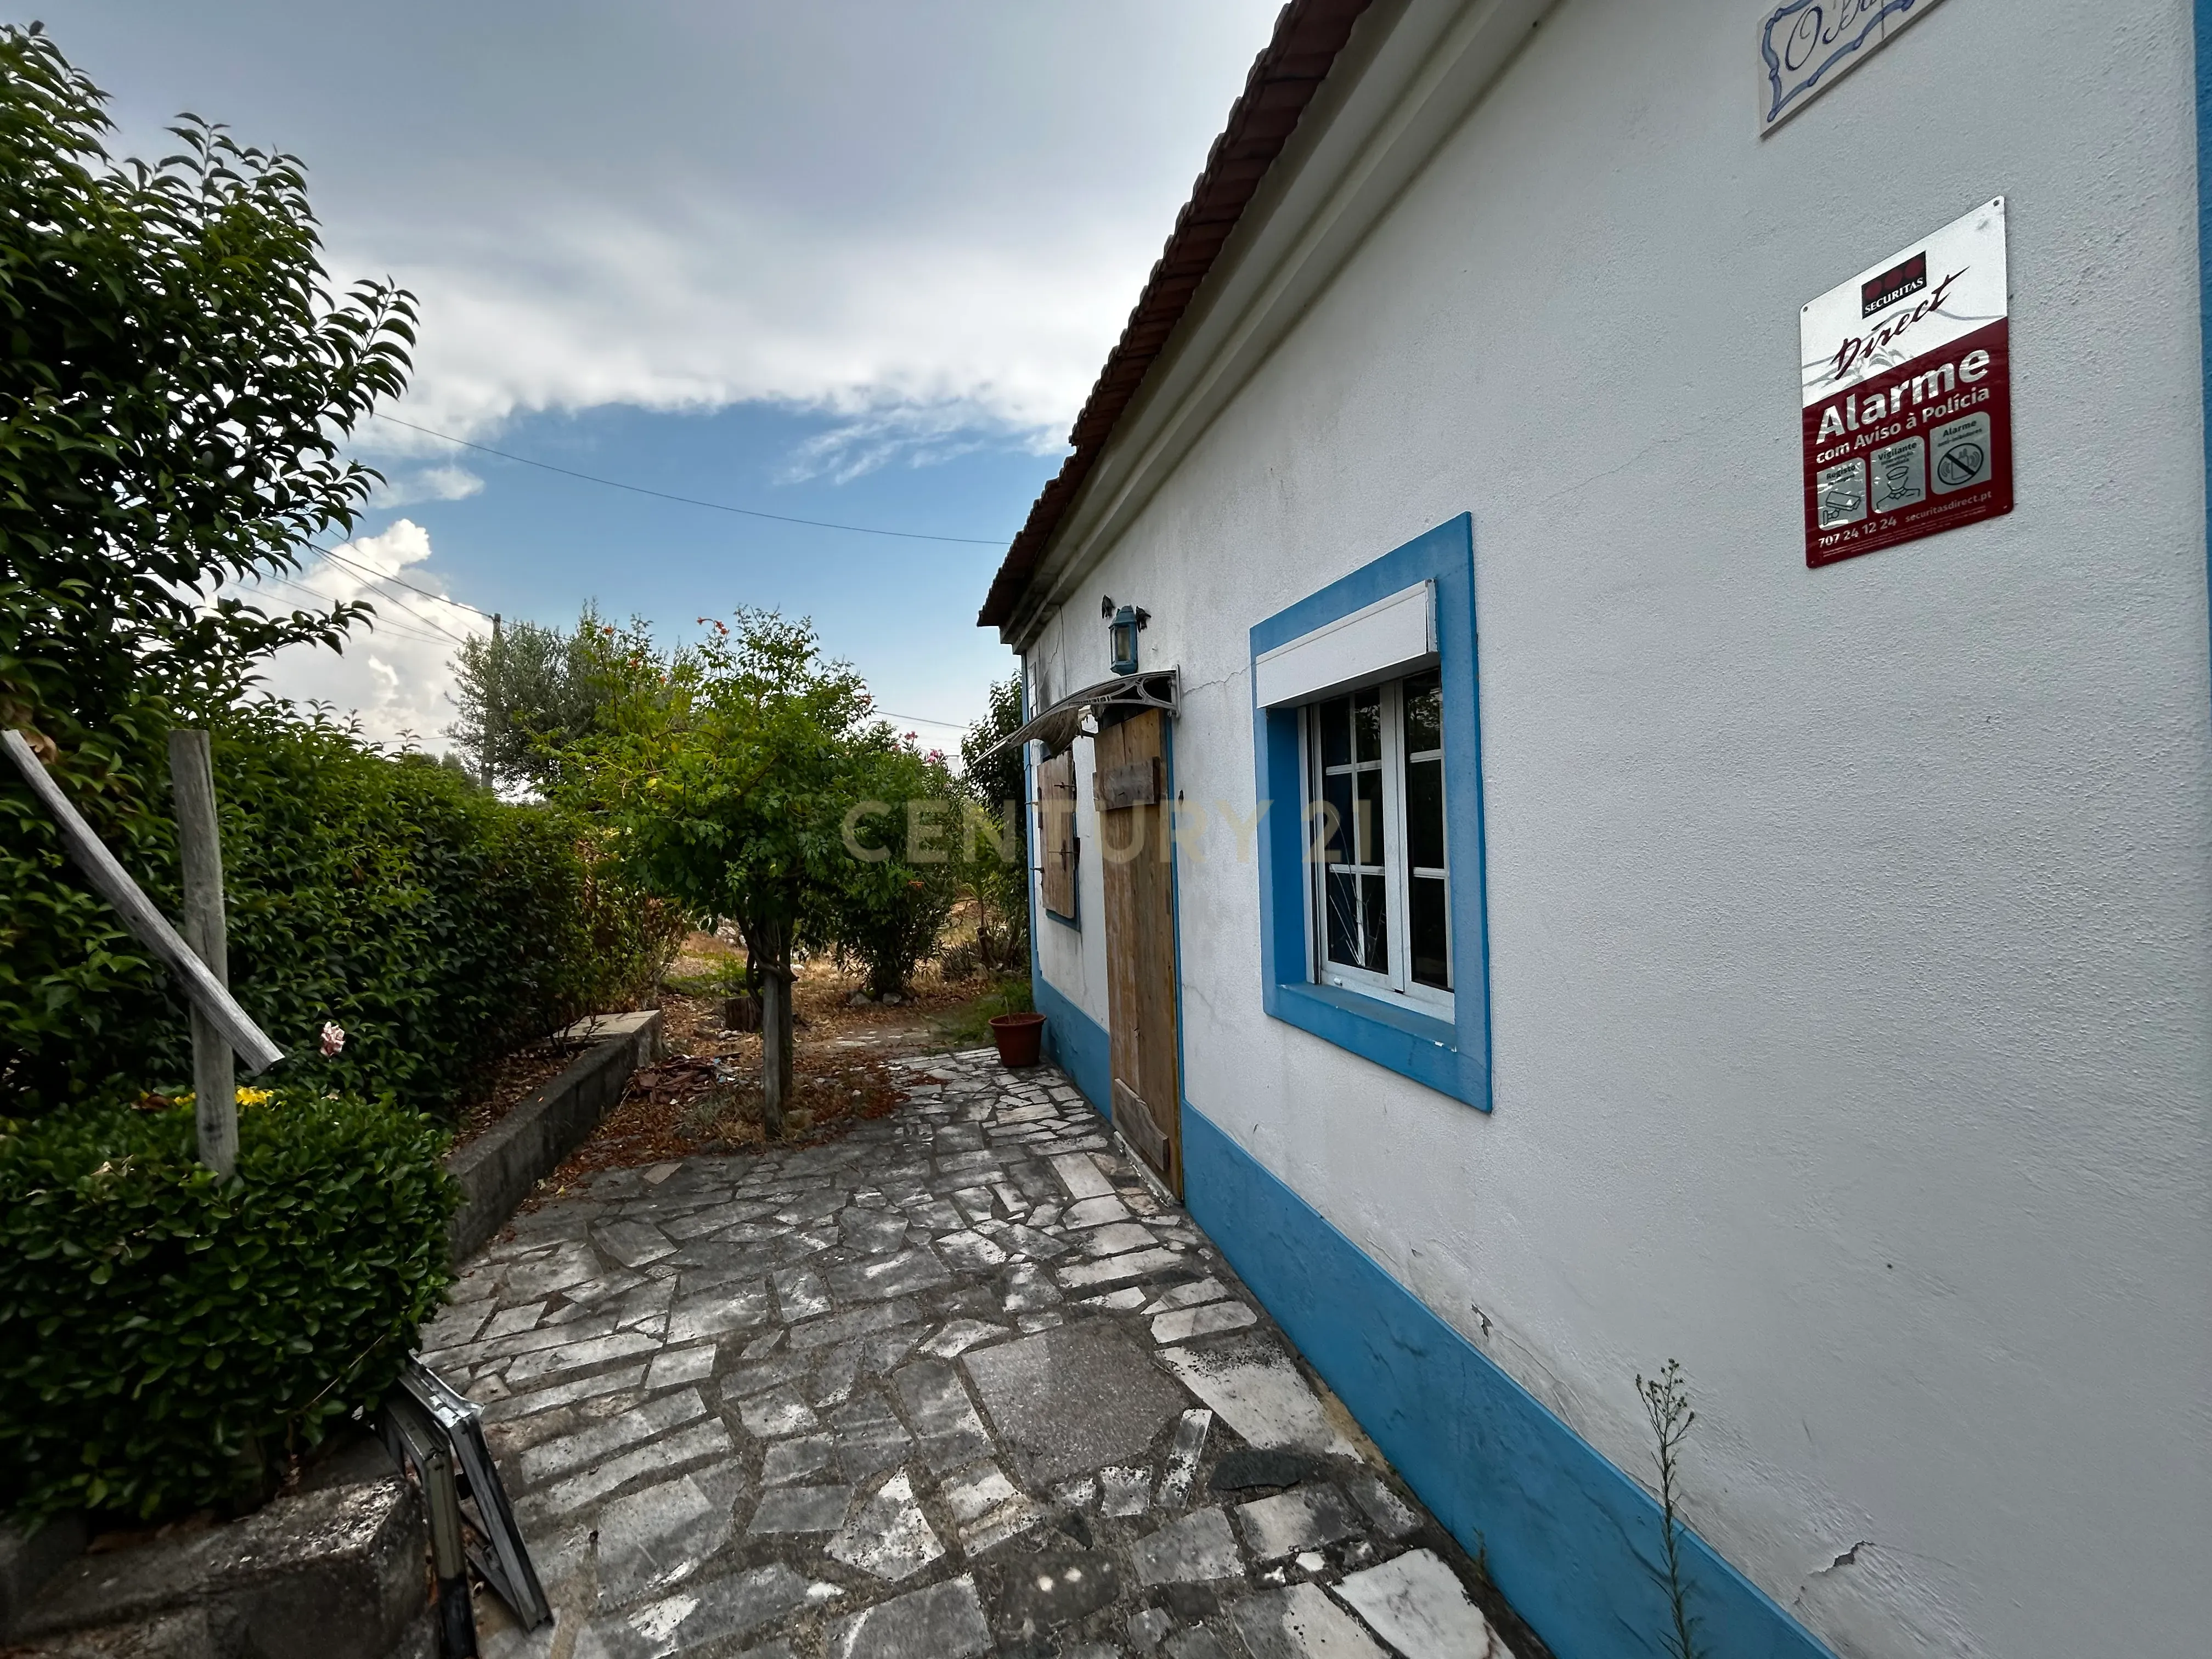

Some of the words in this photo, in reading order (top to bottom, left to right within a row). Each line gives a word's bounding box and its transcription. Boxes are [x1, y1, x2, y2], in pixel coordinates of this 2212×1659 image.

[1865, 276, 1924, 314] SECURITAS
[1829, 266, 1970, 380] Direct
[1816, 349, 1990, 445] Alarme
[1816, 442, 1850, 464] com
[1854, 422, 1901, 450] Aviso
[1905, 412, 1917, 430] à
[1922, 386, 1990, 424] Polícia
[1942, 420, 1977, 438] Alarme
[1826, 465, 1856, 480] Registo
[1877, 442, 1917, 460] Vigilante
[1818, 533, 1840, 548] 707
[1843, 528, 1859, 541] 24
[1861, 522, 1877, 535] 12
[1880, 516, 1897, 530] 24
[1905, 490, 1992, 522] securitasdirect.pt
